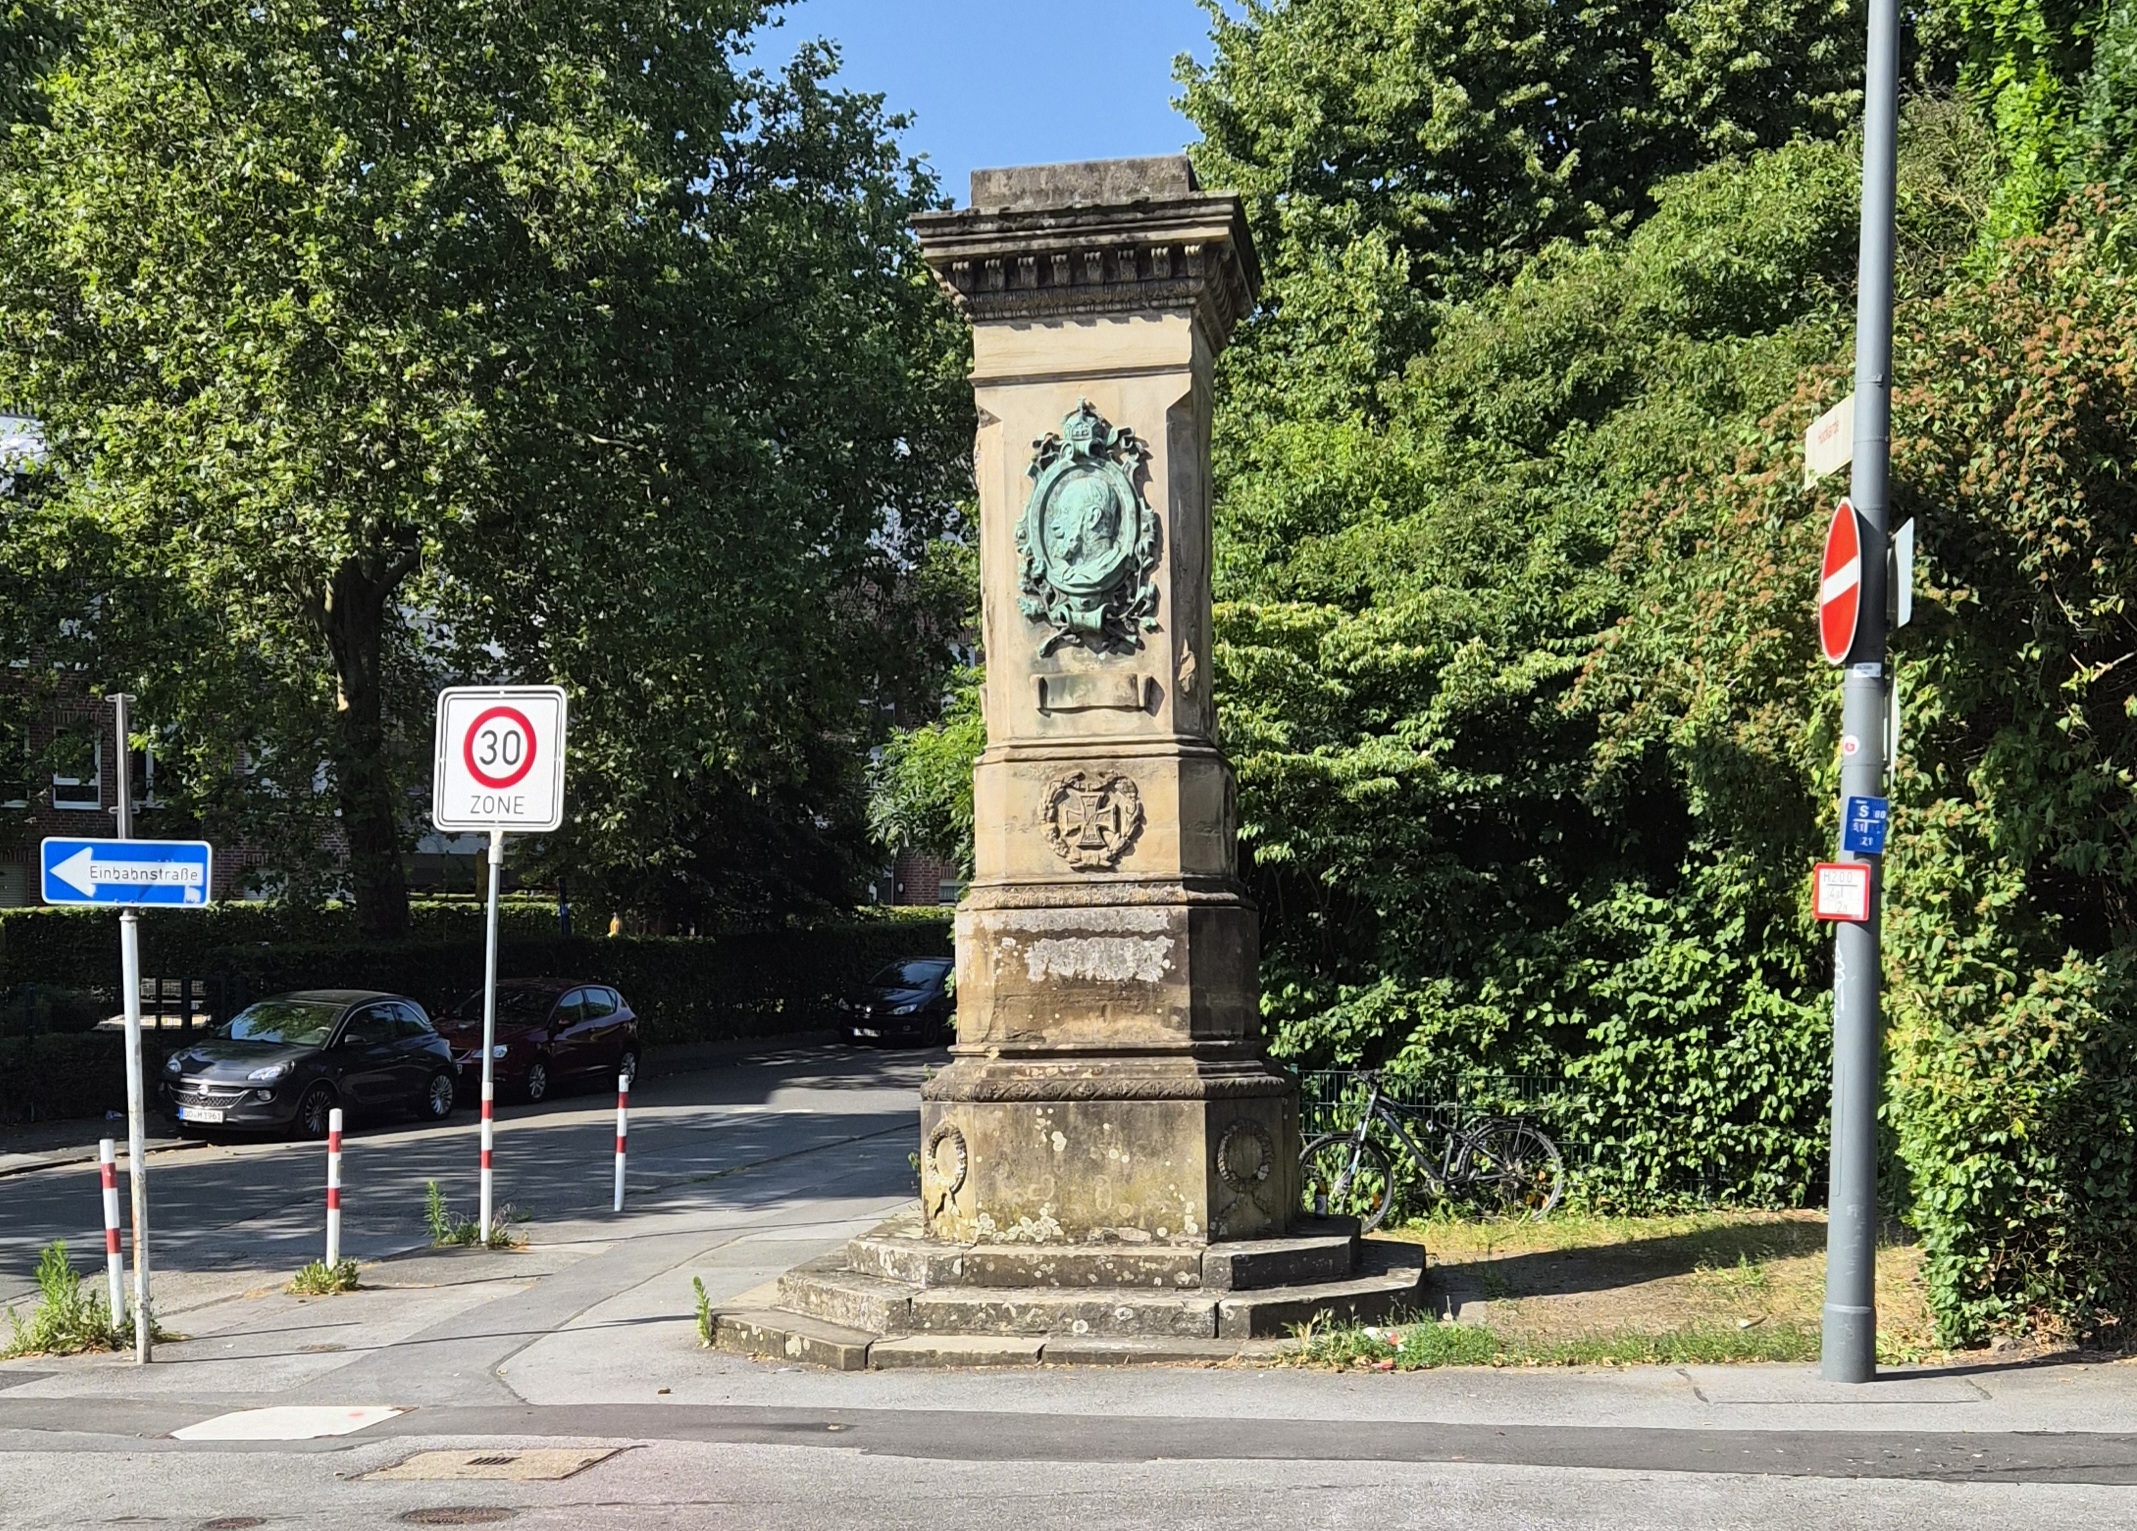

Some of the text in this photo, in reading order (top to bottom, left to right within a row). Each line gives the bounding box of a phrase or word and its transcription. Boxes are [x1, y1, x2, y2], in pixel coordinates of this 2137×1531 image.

[479, 729, 521, 766] 30
[470, 795, 525, 815] ZONE
[1858, 805, 1869, 818] S
[89, 865, 198, 881] Einbahnstraße
